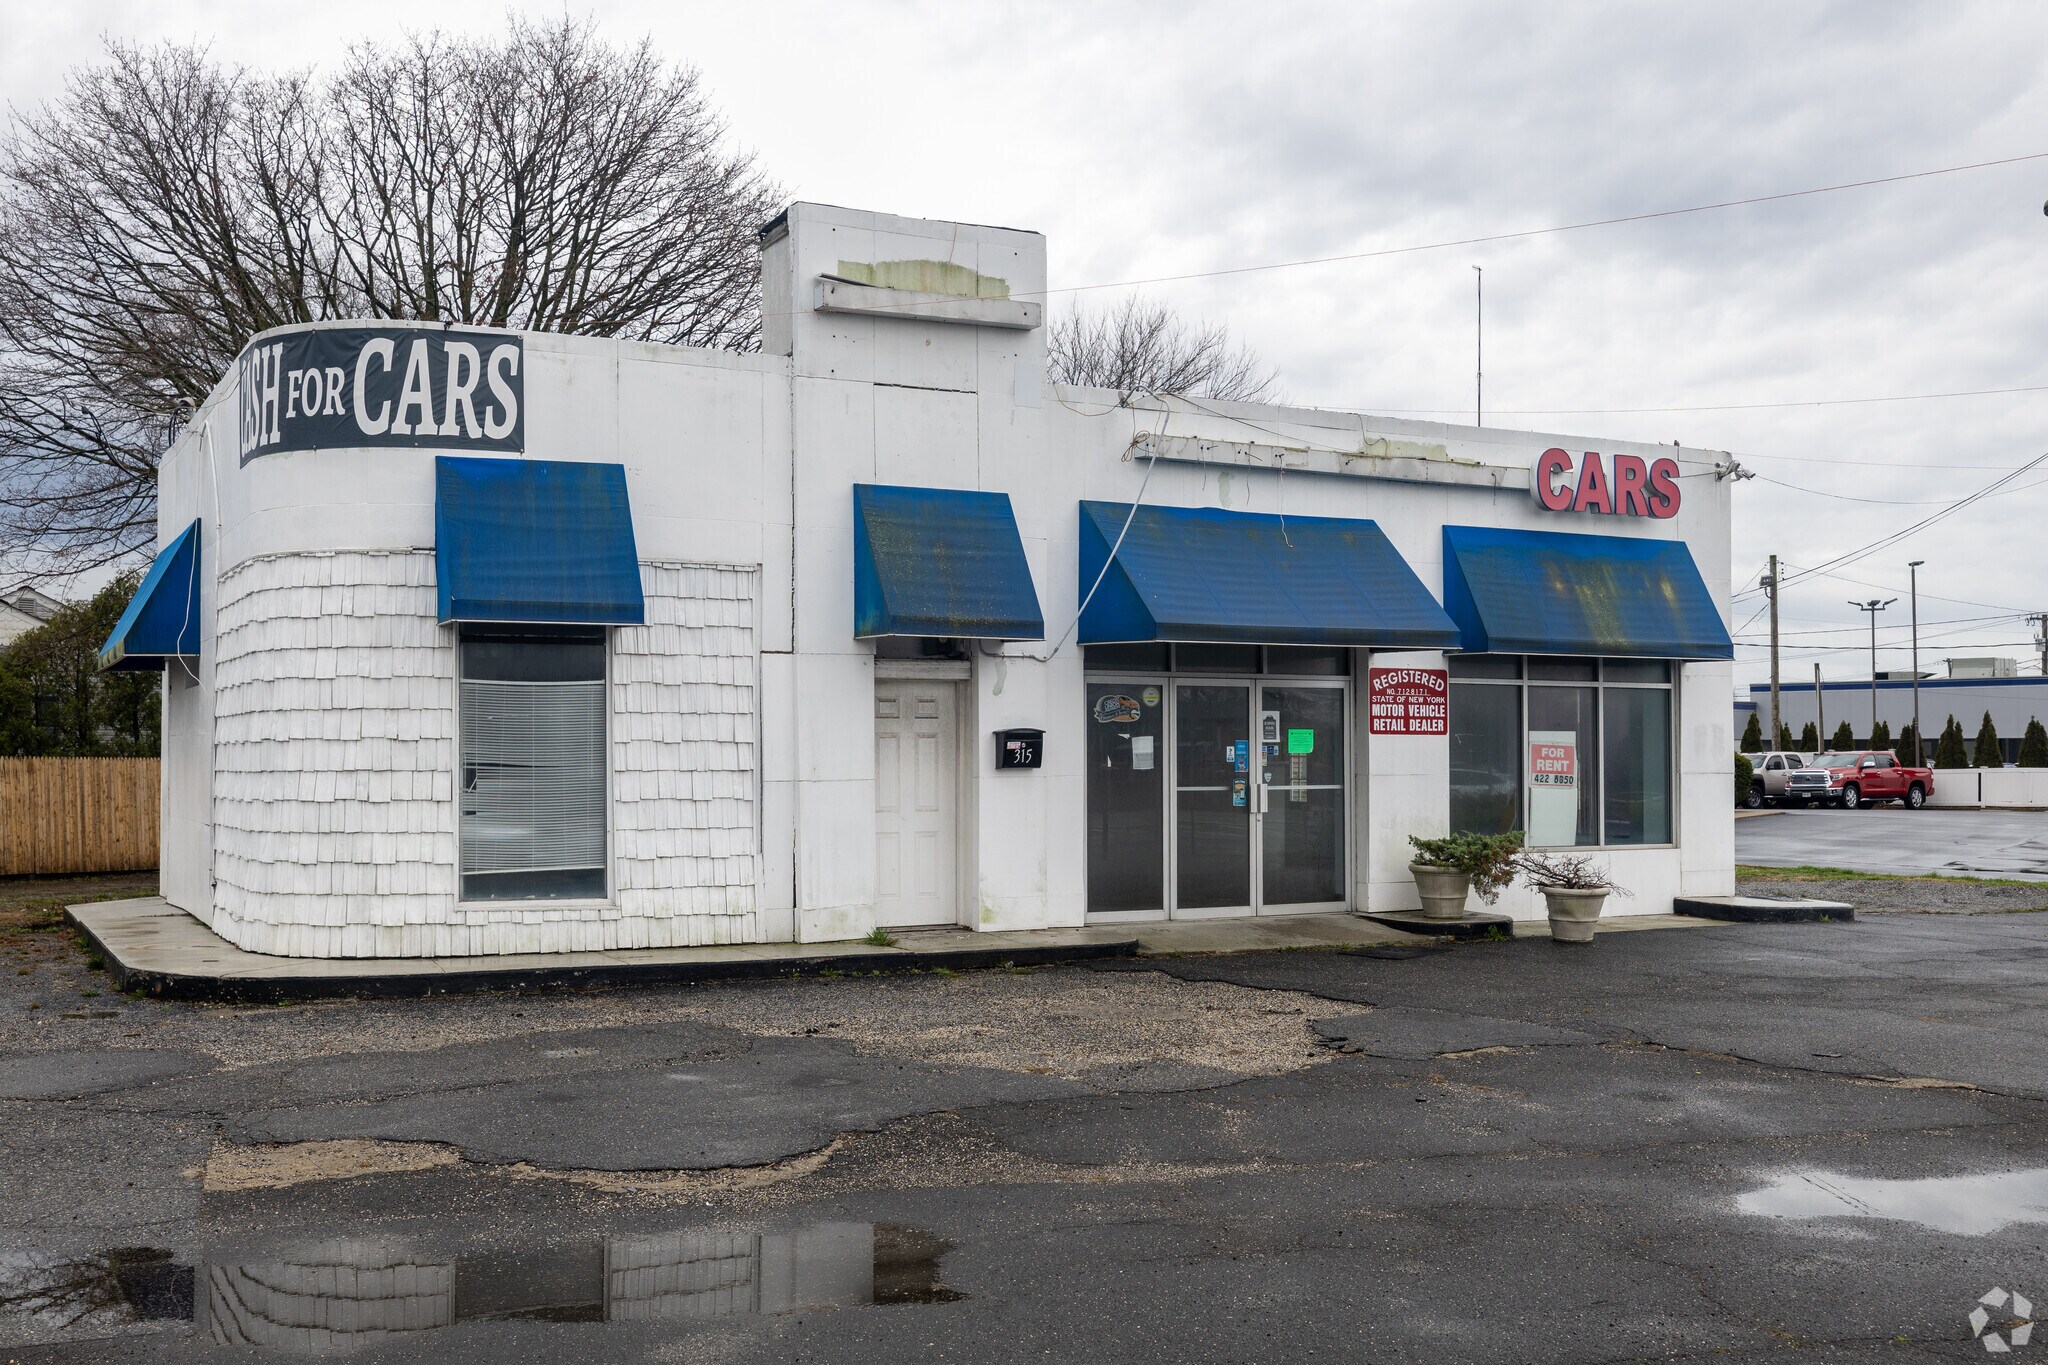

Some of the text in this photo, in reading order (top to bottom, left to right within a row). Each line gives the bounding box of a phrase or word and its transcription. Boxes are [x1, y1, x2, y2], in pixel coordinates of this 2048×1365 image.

[241, 337, 520, 458] CASH FOR CARS
[1534, 447, 1681, 519] CARS
[1373, 670, 1445, 692] REGISTERED
[1372, 695, 1394, 703] STATE
[1426, 696, 1446, 704] YORK
[1372, 703, 1446, 717] MOTOR VEHICLE
[1373, 718, 1444, 732] RETAIL DEALER
[1013, 748, 1033, 764] 315
[1541, 747, 1565, 758] FOR
[1536, 759, 1569, 772] RENT
[1534, 774, 1550, 783] 422
